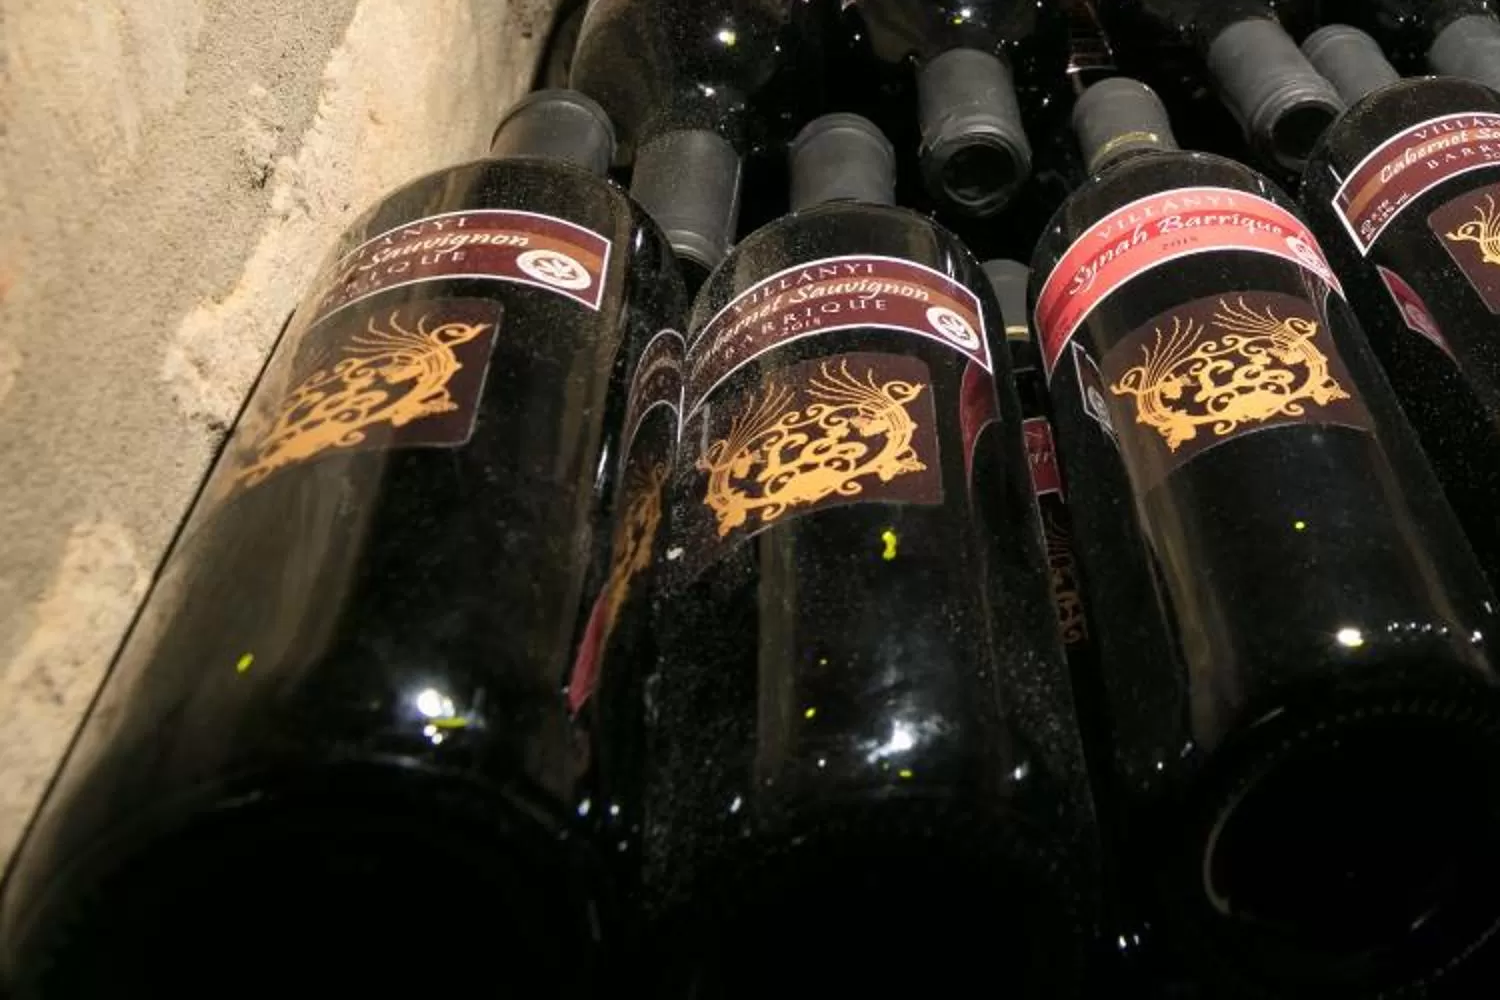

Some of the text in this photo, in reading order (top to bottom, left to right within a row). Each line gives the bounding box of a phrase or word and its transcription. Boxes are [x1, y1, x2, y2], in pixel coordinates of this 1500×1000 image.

[1380, 130, 1469, 184] Cabernet
[1157, 213, 1283, 235] Barrique
[359, 232, 530, 271] Sauvignon
[789, 277, 930, 304] Sauvignon
